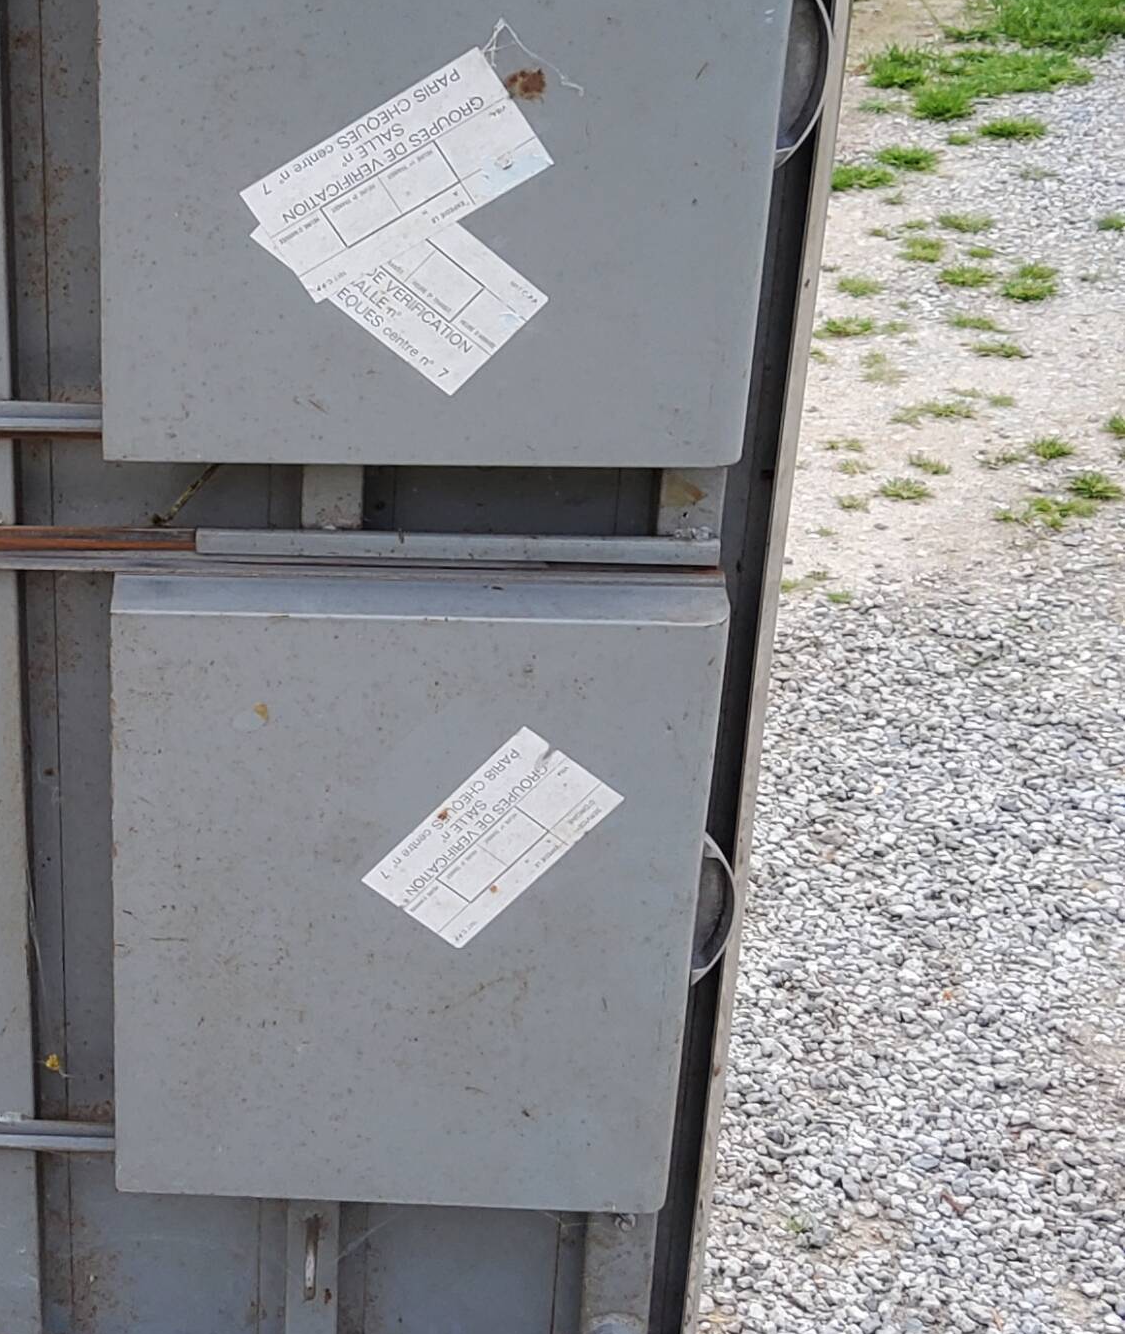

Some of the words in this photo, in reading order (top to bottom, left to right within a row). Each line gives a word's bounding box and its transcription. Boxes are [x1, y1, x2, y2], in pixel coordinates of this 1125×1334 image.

[411, 67, 462, 104] PARIS
[334, 95, 413, 151] CHEQUES
[406, 93, 486, 148] GROUPES
[291, 142, 336, 175] centre
[354, 121, 406, 159] SALLE
[382, 141, 408, 163] DE
[259, 181, 272, 195] 7
[280, 155, 384, 225] VERIFICATION
[349, 277, 390, 309] ALLE
[385, 279, 473, 354] VERIFICATION
[381, 325, 420, 357] centre
[437, 367, 449, 378] 7
[482, 748, 520, 781] PARIS
[430, 782, 485, 830] CHEQUES
[491, 765, 548, 815] GROUPES
[449, 799, 487, 833] SALLE
[473, 813, 495, 831] DE
[400, 828, 431, 858] centre
[379, 870, 390, 879] 7
[404, 829, 478, 896] VERIFICATION
